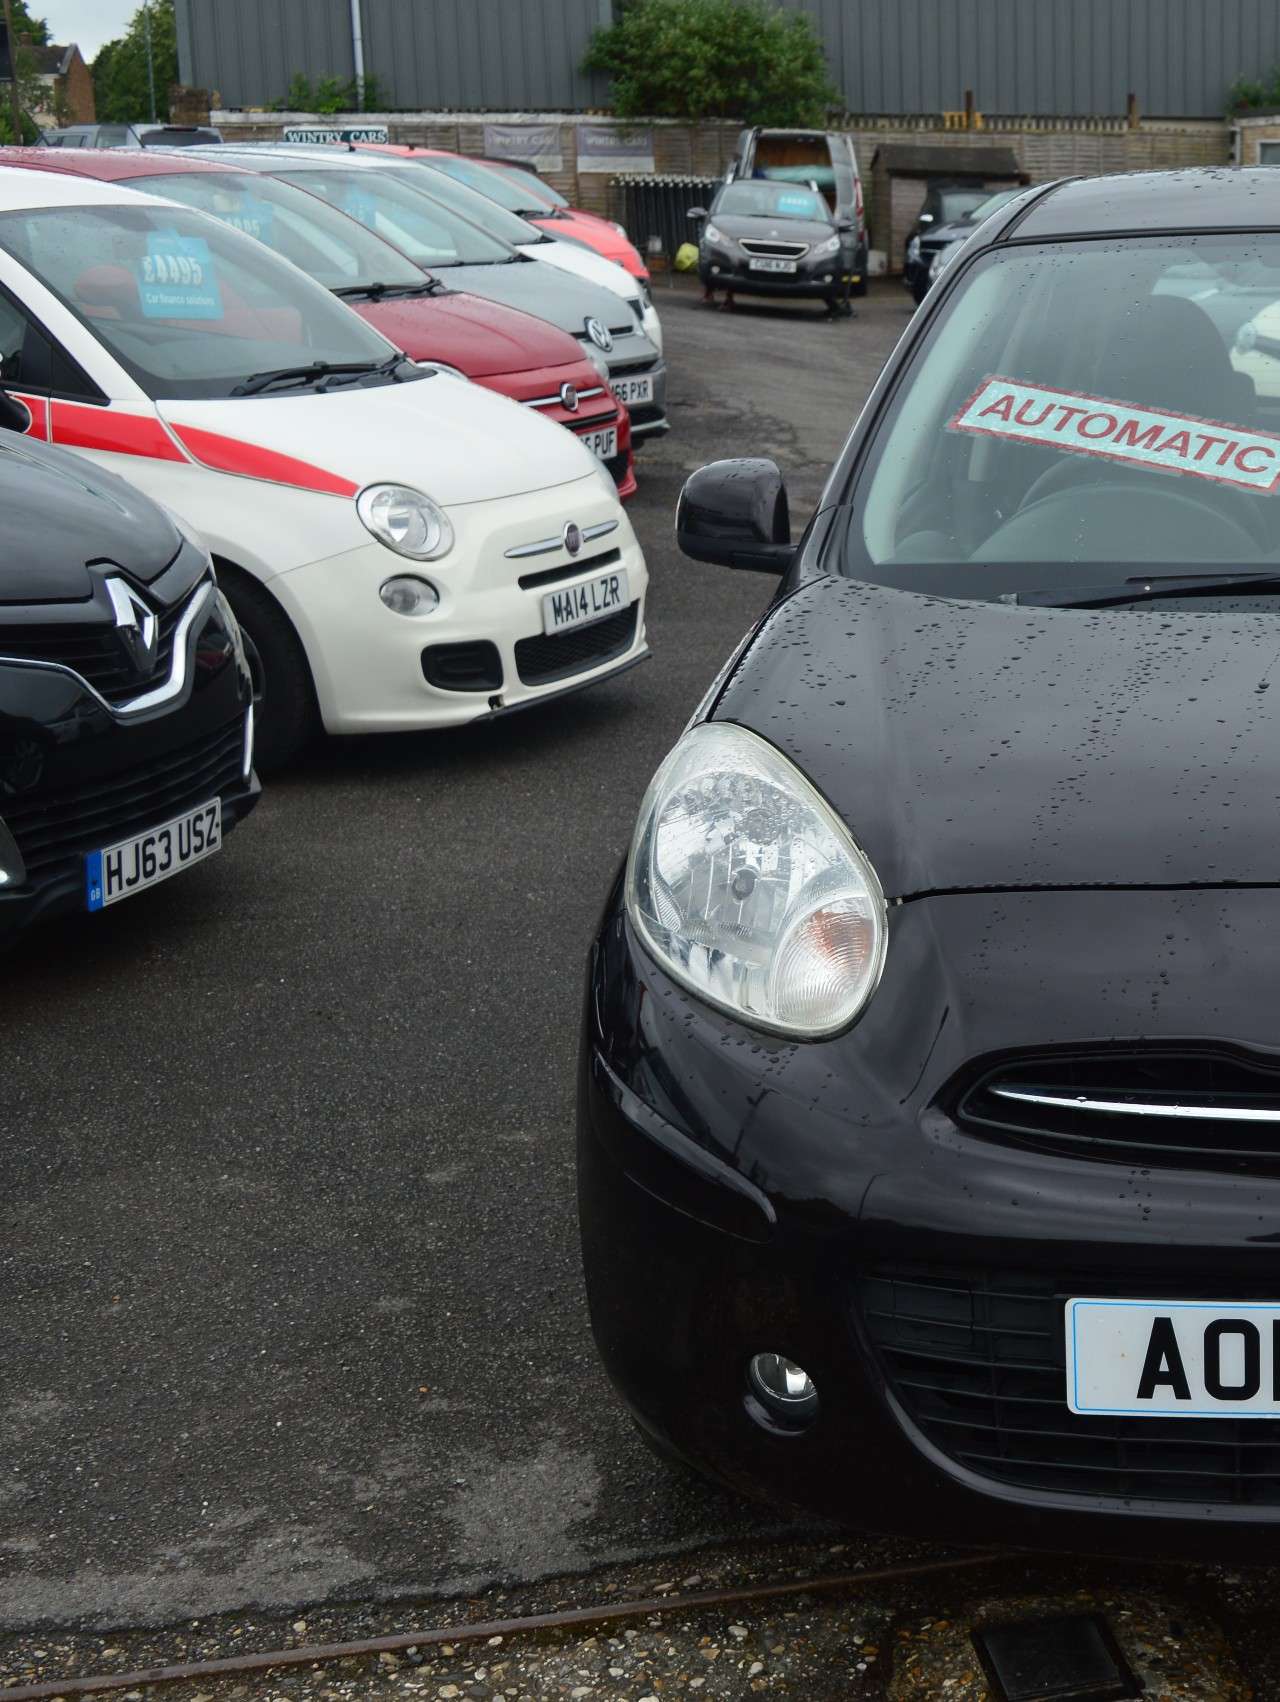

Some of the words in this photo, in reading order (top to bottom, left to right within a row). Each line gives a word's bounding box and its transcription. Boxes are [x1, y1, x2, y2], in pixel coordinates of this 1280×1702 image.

[288, 131, 342, 143] WINTRY
[350, 131, 386, 144] CARS
[629, 380, 649, 401] PXR
[594, 430, 615, 455] PUF
[977, 394, 1277, 474] AUTOMATIC
[552, 586, 589, 626] MA14
[591, 575, 620, 612] LZR
[106, 829, 172, 896] HJ63
[178, 805, 217, 862] USZ
